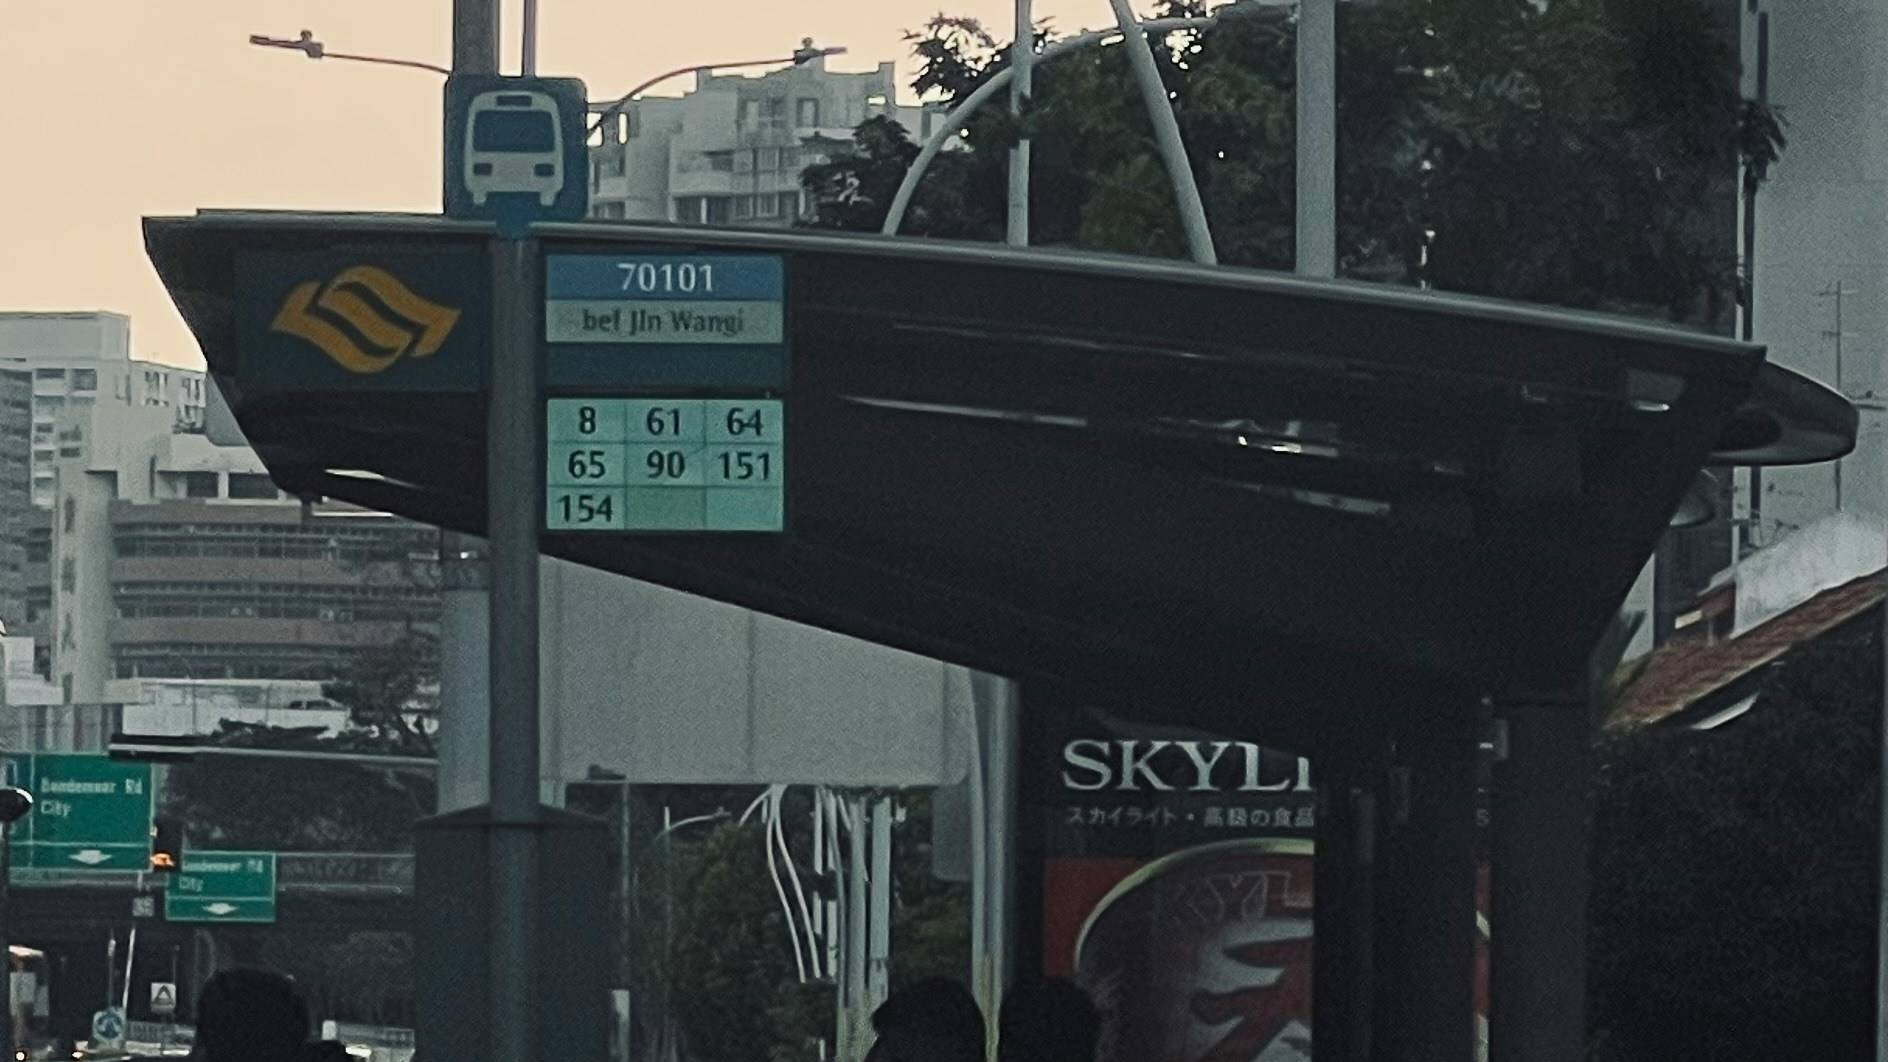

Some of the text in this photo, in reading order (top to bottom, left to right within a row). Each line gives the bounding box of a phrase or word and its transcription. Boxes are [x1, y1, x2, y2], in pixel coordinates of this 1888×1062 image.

[617, 262, 714, 292] 70101
[582, 308, 621, 332] bef
[670, 307, 744, 337] Wangi
[578, 406, 764, 436] 8 61 64
[568, 450, 770, 480] 65 90 151
[557, 494, 613, 523] 154
